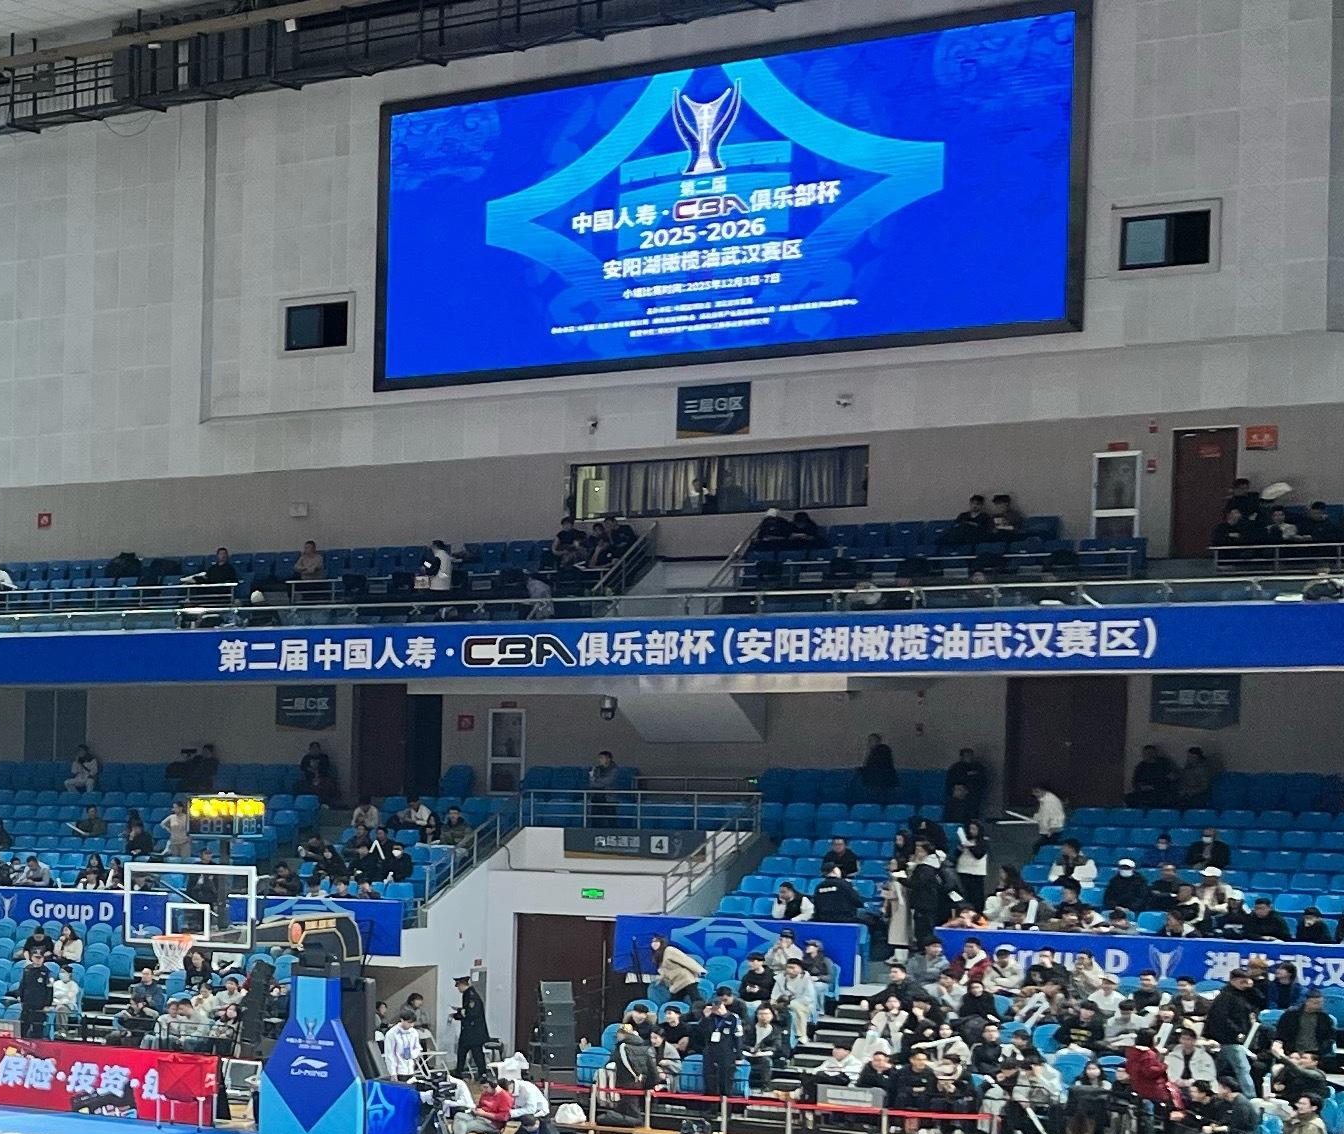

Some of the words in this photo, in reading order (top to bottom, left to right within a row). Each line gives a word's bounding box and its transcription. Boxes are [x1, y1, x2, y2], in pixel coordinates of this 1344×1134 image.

[639, 218, 766, 249] 2025-2026
[29, 898, 94, 926] Group
[98, 901, 114, 921] D
